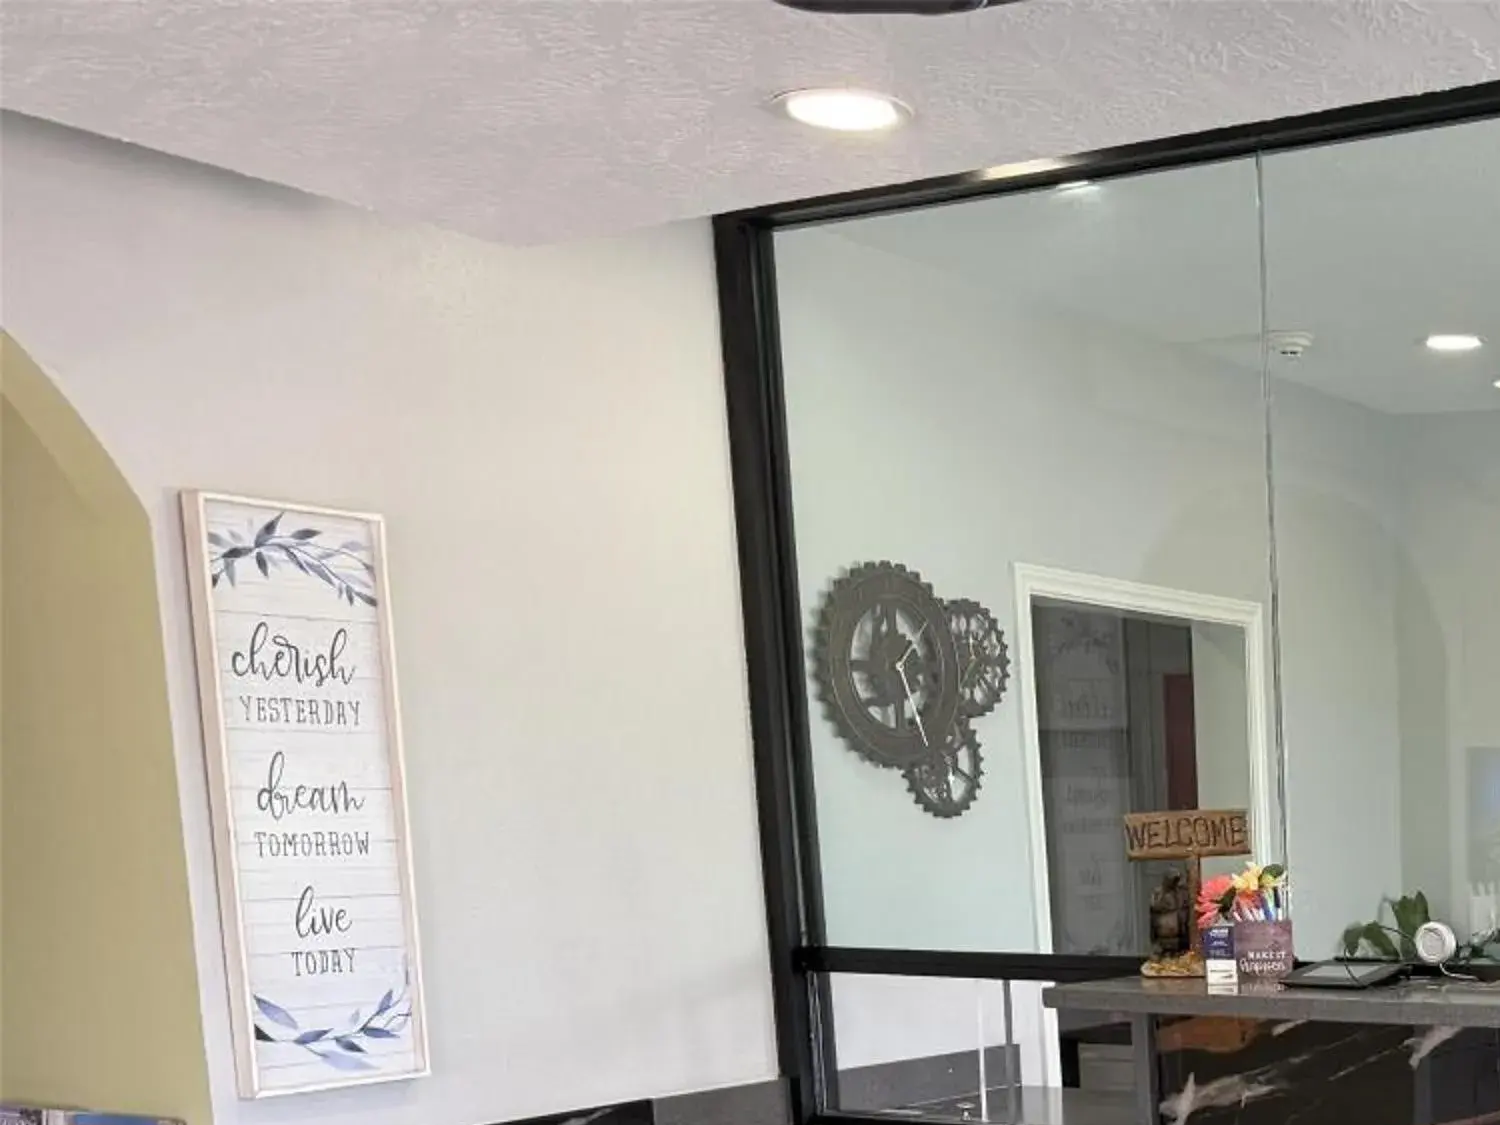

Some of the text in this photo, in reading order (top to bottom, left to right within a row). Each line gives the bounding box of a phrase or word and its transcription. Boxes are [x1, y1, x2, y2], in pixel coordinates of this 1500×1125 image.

[232, 622, 354, 686] cherish
[240, 696, 361, 727] YESTERDAY
[257, 751, 366, 822] dream
[255, 831, 370, 858] TOMORROW
[1125, 815, 1246, 849] WELCOME
[295, 885, 353, 940] live
[292, 949, 356, 977] TODAY
